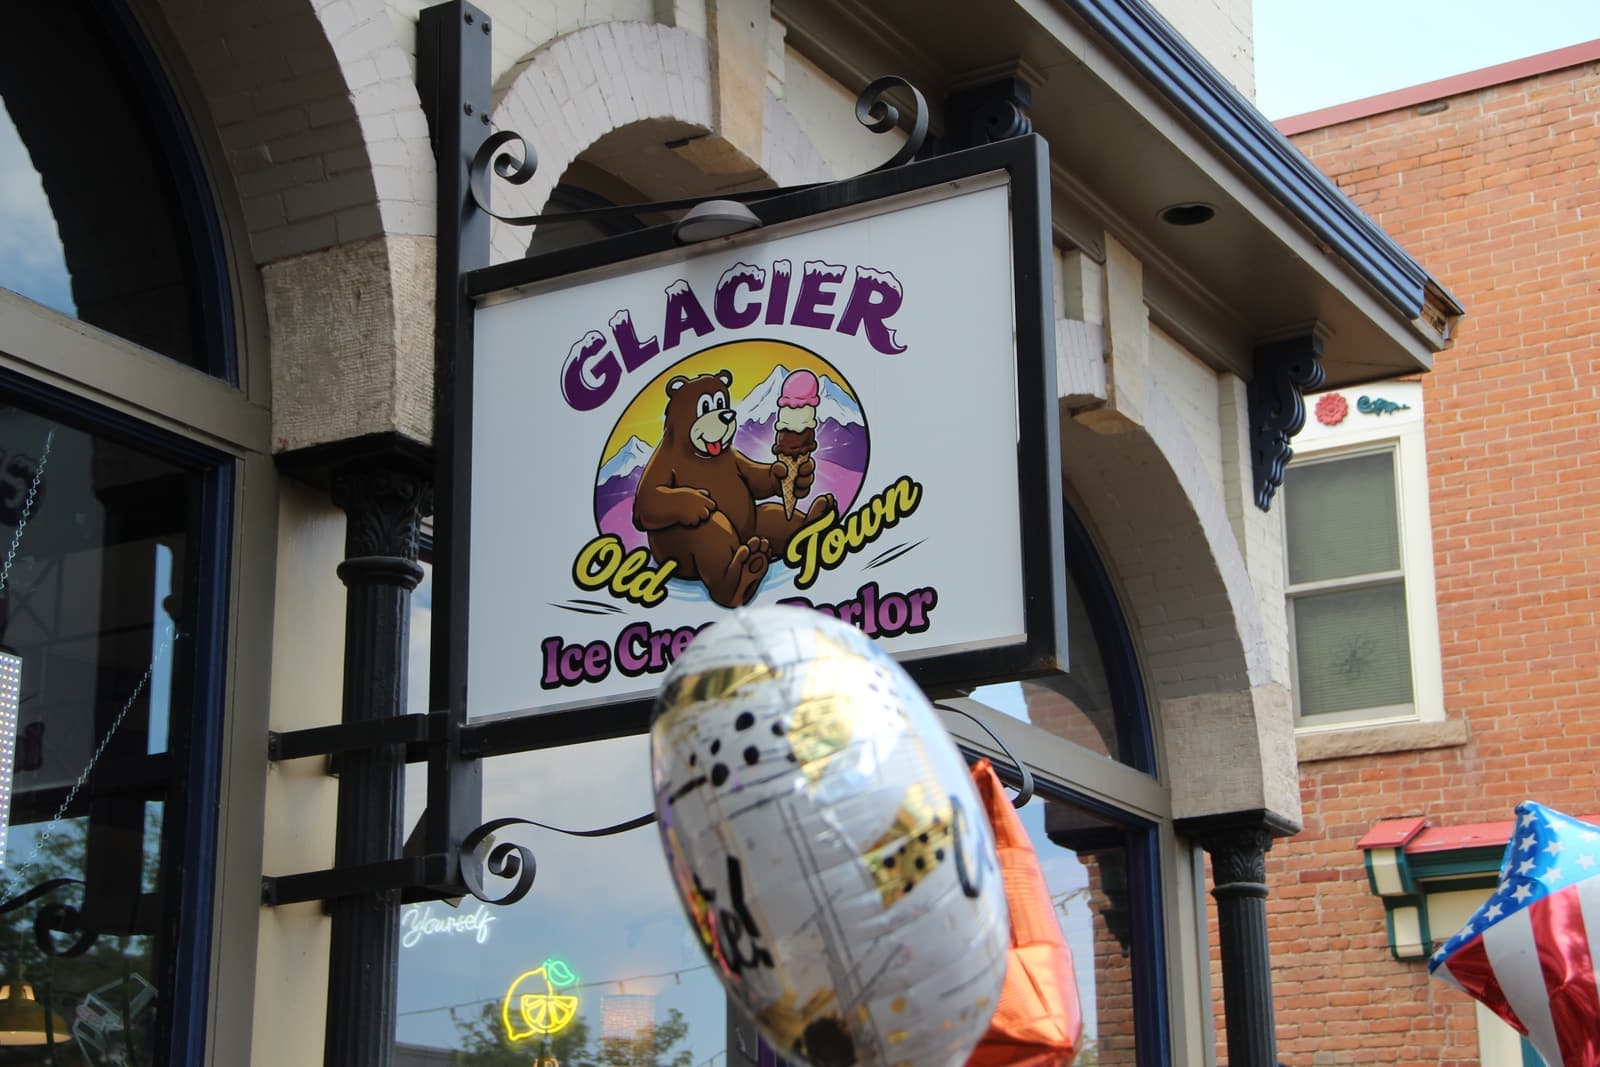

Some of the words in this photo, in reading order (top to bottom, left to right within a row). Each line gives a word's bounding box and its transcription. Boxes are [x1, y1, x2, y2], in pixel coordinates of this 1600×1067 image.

[560, 259, 908, 412] GLACIER
[572, 534, 681, 608] Old
[785, 476, 922, 589] Town
[541, 636, 611, 690] Ice
[614, 621, 717, 677] Cre
[776, 581, 938, 640] rlor
